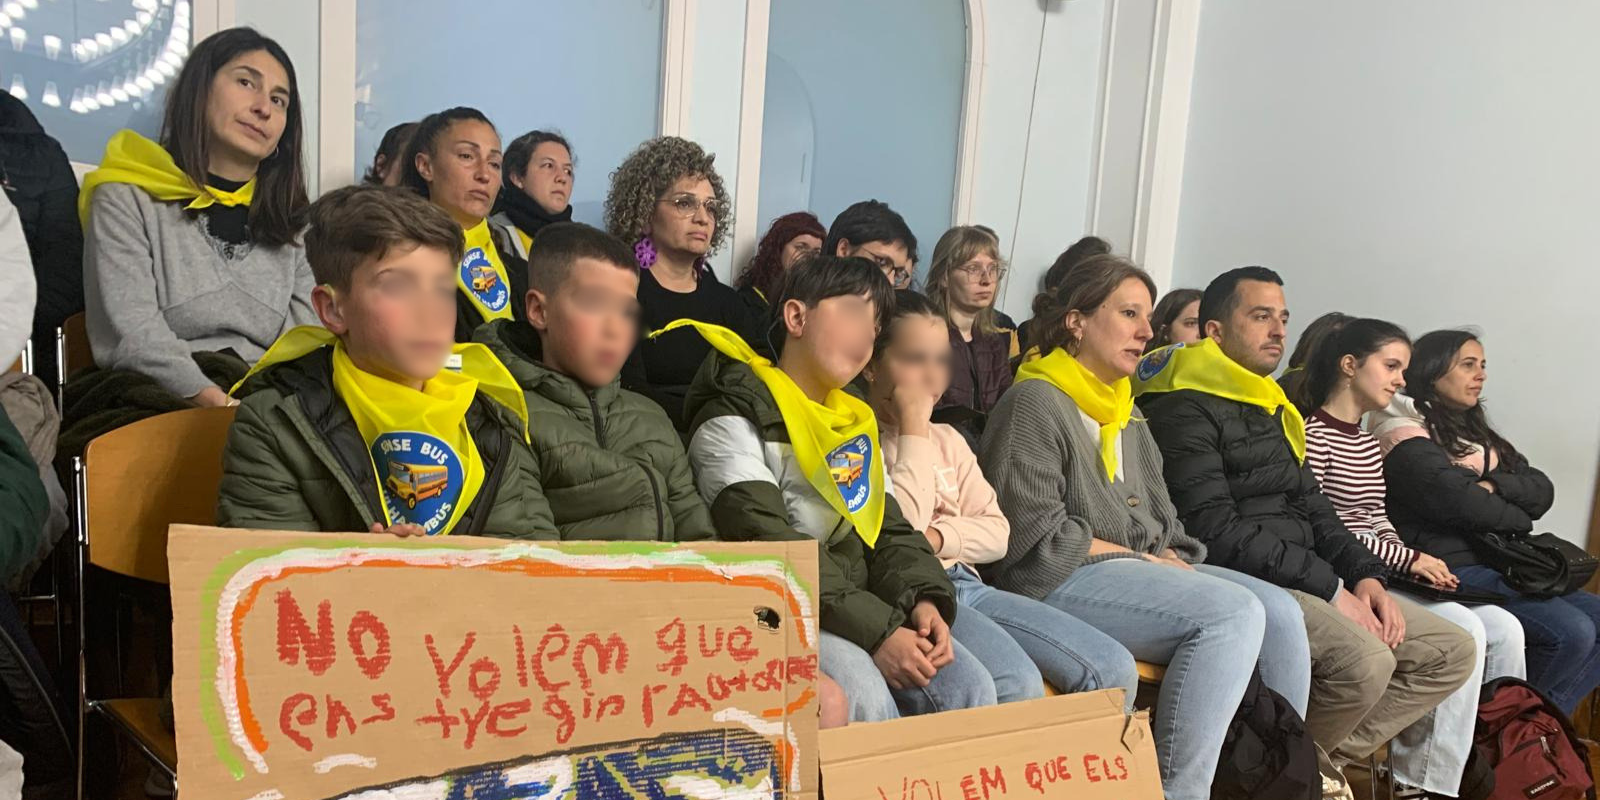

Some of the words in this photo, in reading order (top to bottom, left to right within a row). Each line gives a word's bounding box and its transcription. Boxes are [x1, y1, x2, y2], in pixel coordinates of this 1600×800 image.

[420, 442, 448, 465] BUS
[655, 617, 760, 676] que
[279, 692, 396, 752] ens
[1024, 755, 1072, 795] QUE
[1083, 753, 1129, 783] ELS
